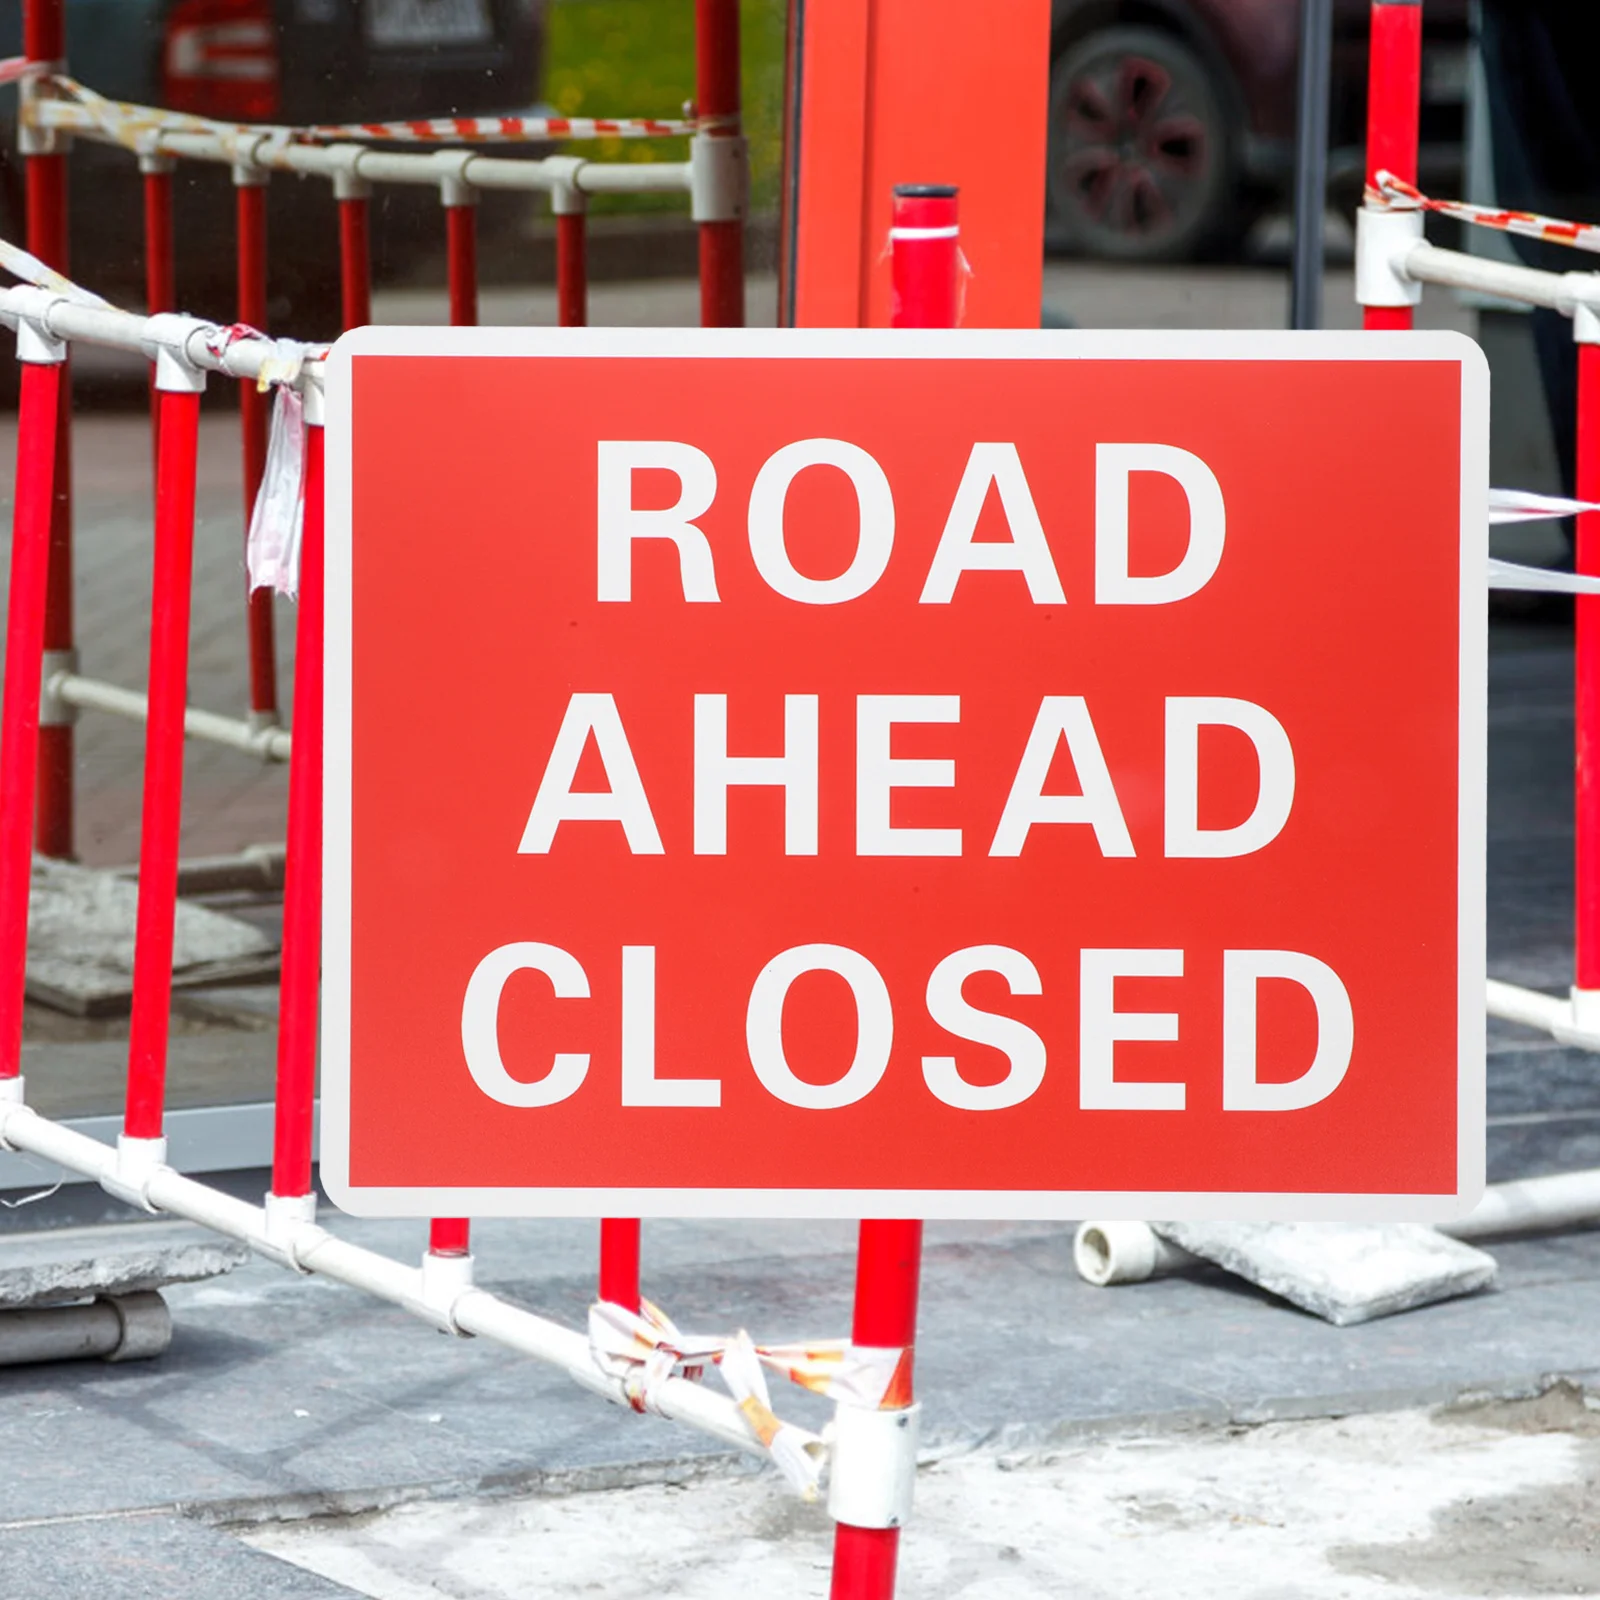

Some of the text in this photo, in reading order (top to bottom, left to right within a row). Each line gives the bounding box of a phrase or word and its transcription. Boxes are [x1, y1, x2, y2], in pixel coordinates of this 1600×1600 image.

[597, 437, 1227, 605] ROAD
[516, 692, 1296, 859] AHEAD
[460, 941, 1355, 1112] CLOSED
